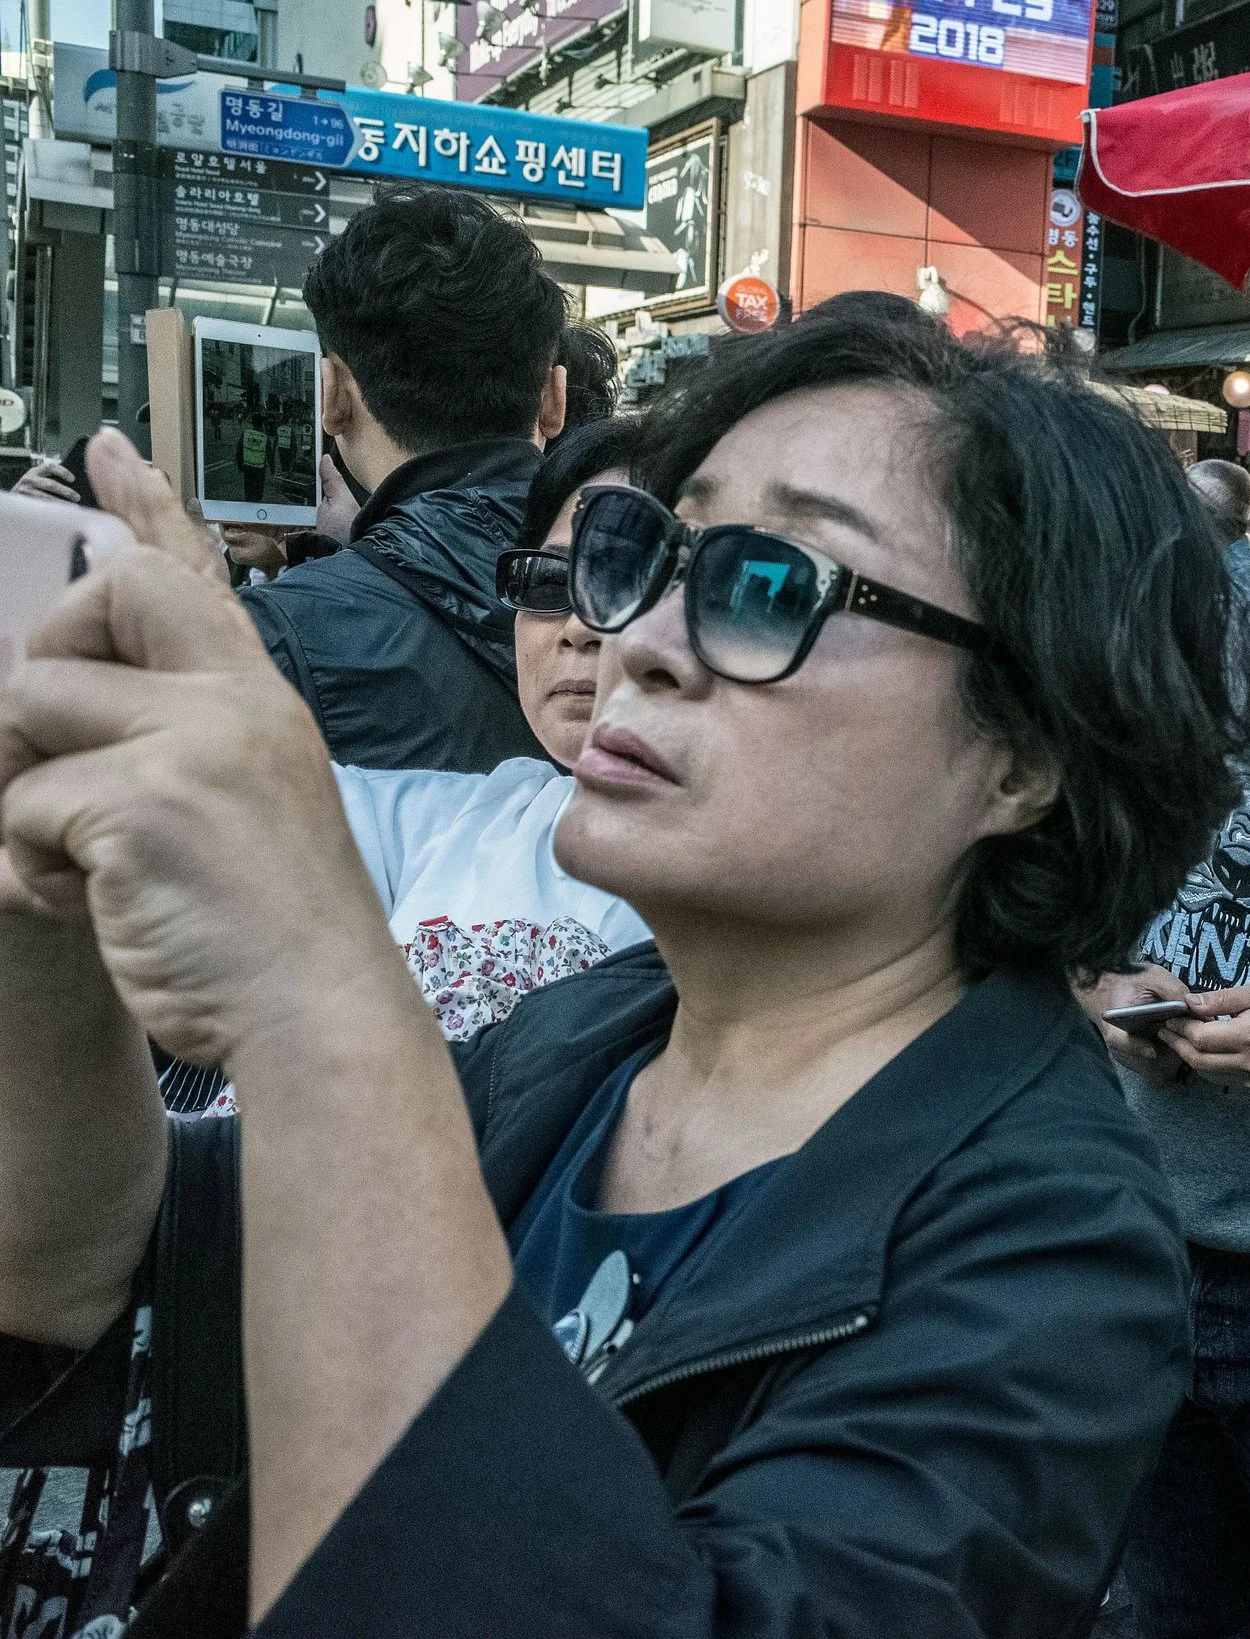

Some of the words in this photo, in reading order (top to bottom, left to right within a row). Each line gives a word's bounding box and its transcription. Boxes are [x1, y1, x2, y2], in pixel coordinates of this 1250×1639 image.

[909, 13, 1005, 64] 2018
[225, 96, 283, 122] 명동길
[225, 119, 344, 148] Myeongdong-gil
[174, 151, 267, 175] 로얄호텔서울
[352, 116, 623, 193] 동지하쇼핑센터
[174, 185, 260, 207] 솔라리아호텔
[175, 217, 240, 236] 명동대성당
[175, 250, 252, 270] 명동예술극장
[734, 292, 768, 309] TAX
[1046, 249, 1079, 328] 스타
